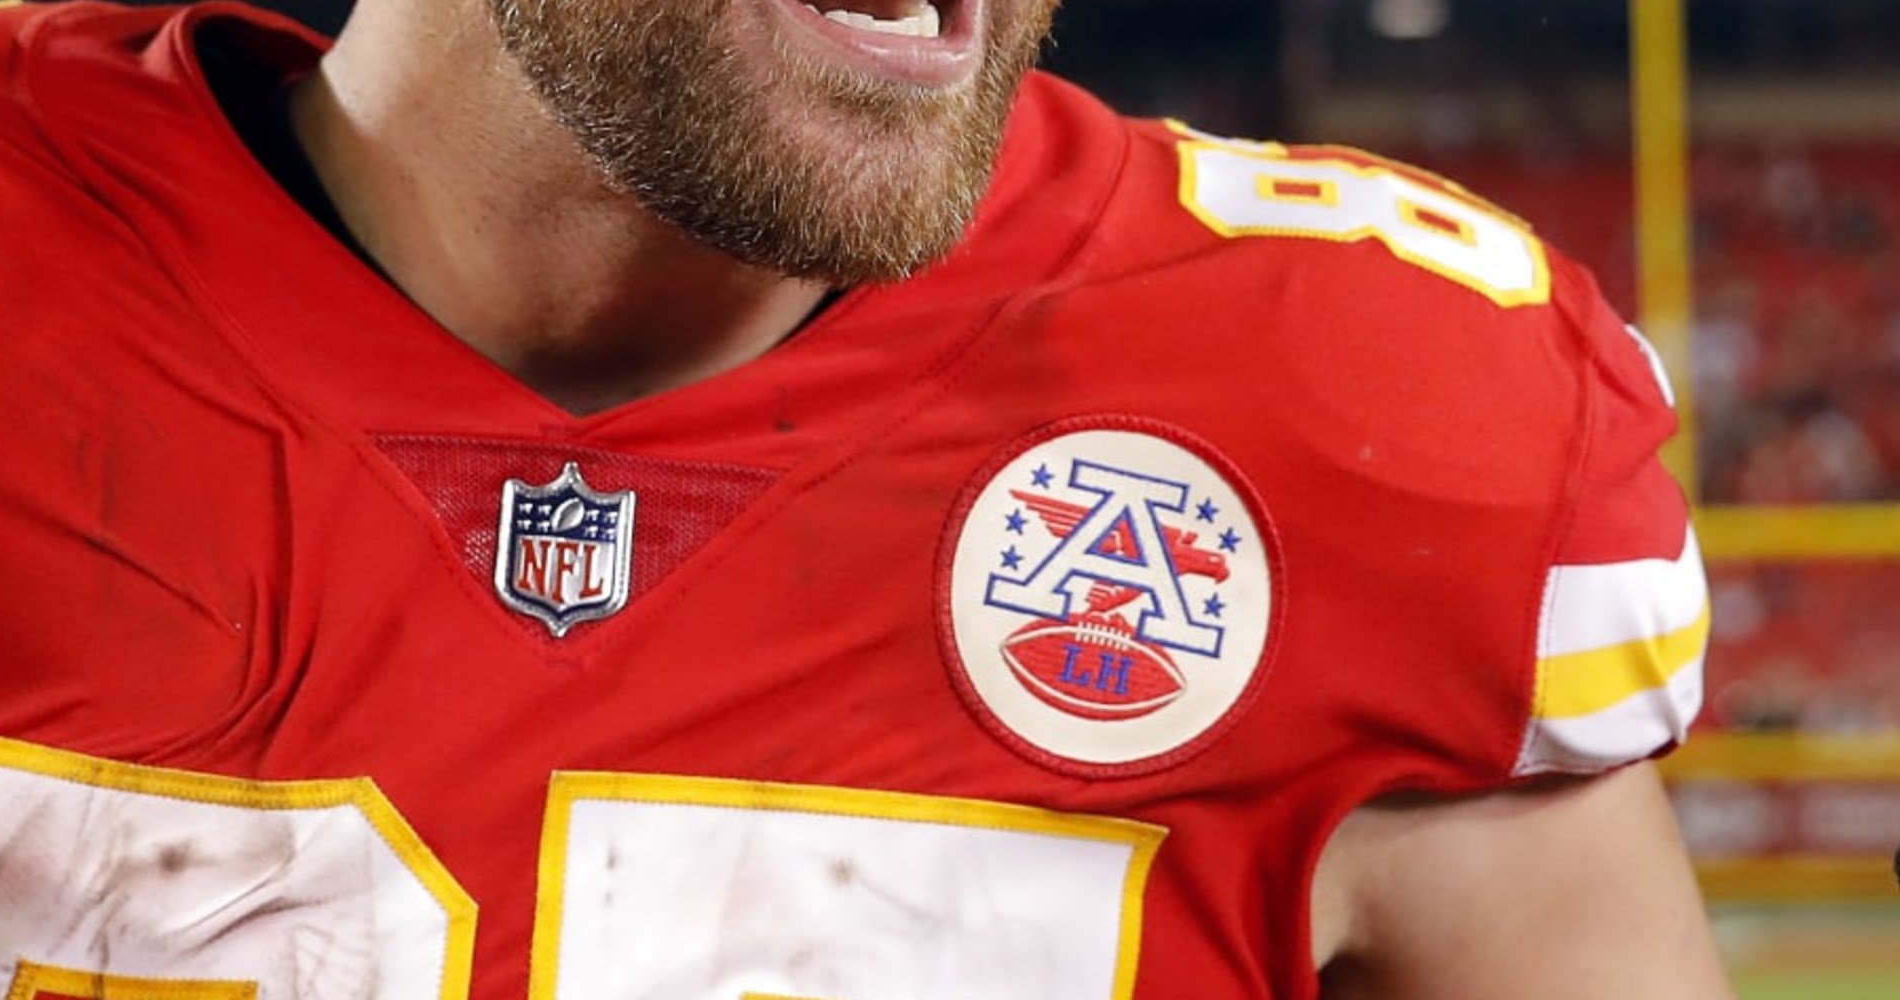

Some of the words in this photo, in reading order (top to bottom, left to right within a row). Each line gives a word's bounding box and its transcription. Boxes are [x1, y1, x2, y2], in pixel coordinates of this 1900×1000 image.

[1163, 117, 1552, 309] 8
[517, 537, 605, 604] NFL
[1058, 643, 1137, 697] LH
